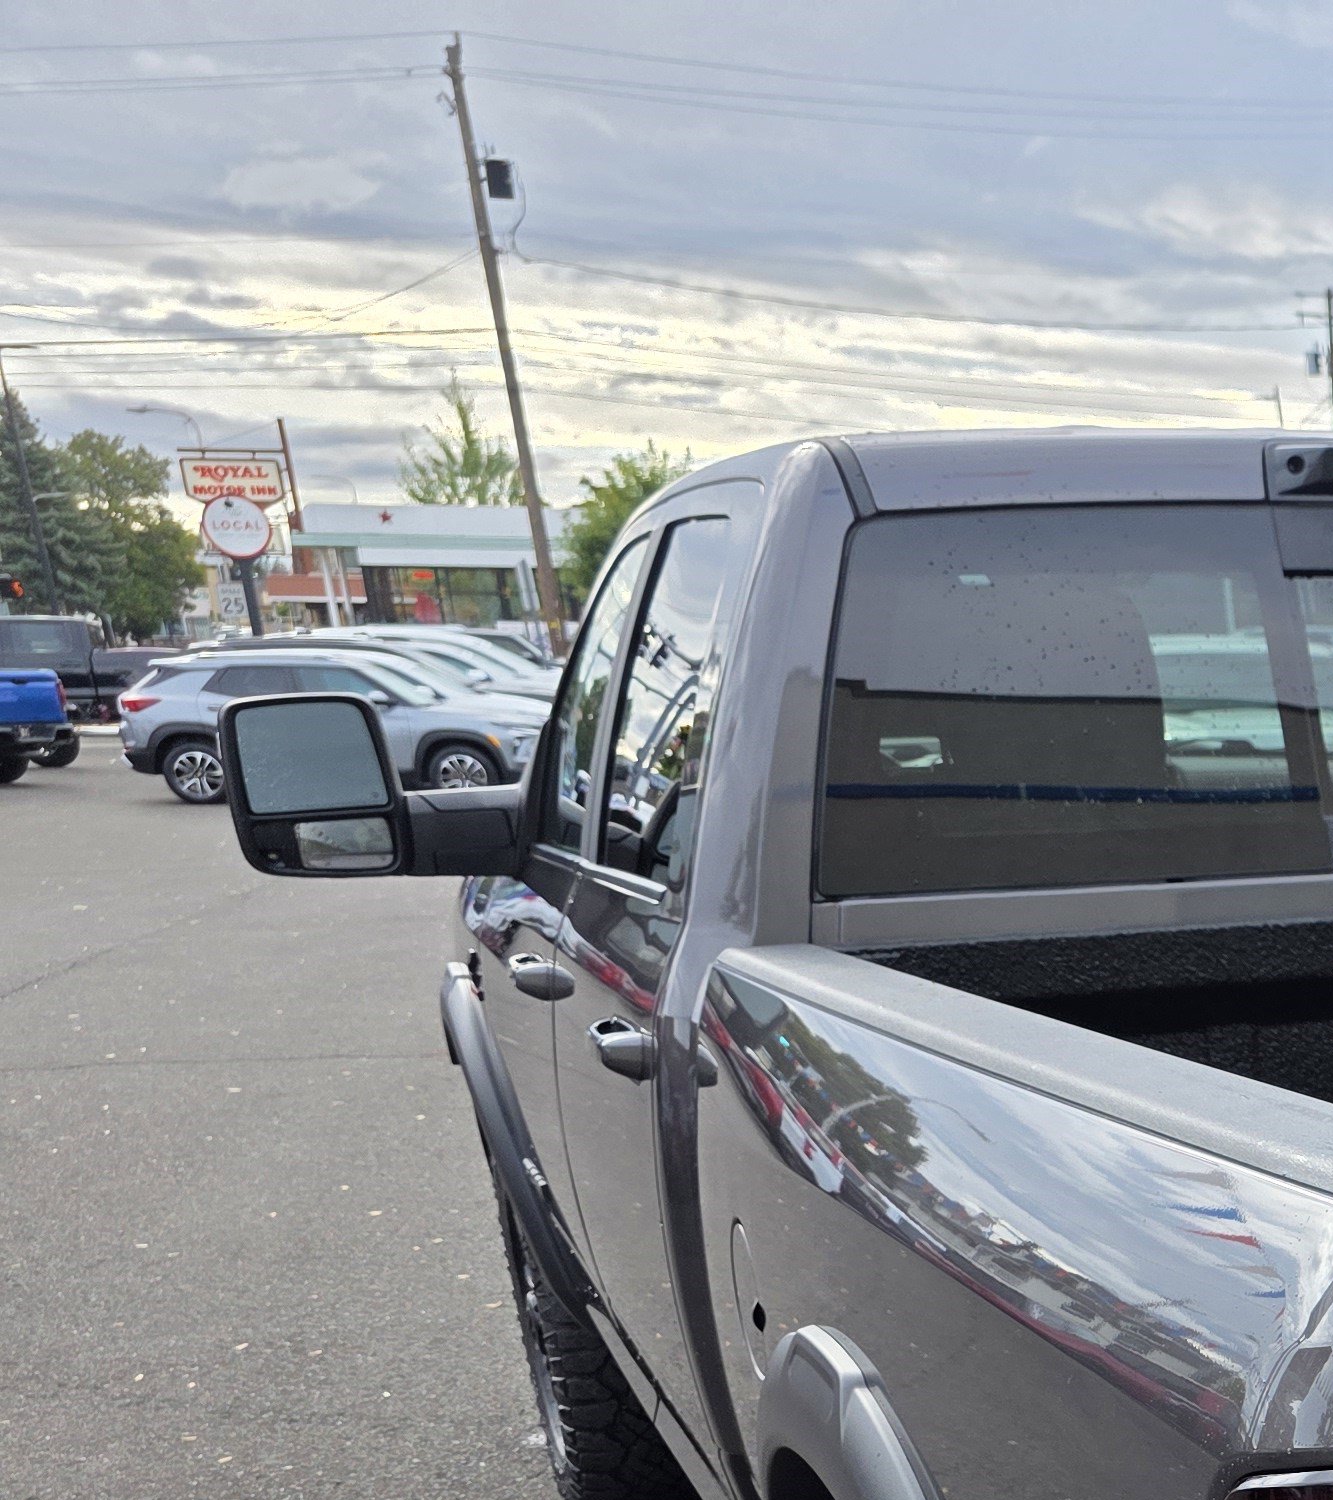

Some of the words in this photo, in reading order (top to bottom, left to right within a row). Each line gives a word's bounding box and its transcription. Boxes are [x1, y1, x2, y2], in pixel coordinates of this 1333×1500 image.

[193, 465, 269, 482] ROYAL
[193, 485, 246, 496] MOTOR
[250, 485, 277, 496] INN
[212, 520, 261, 530] LOCAL
[222, 597, 244, 614] 25
